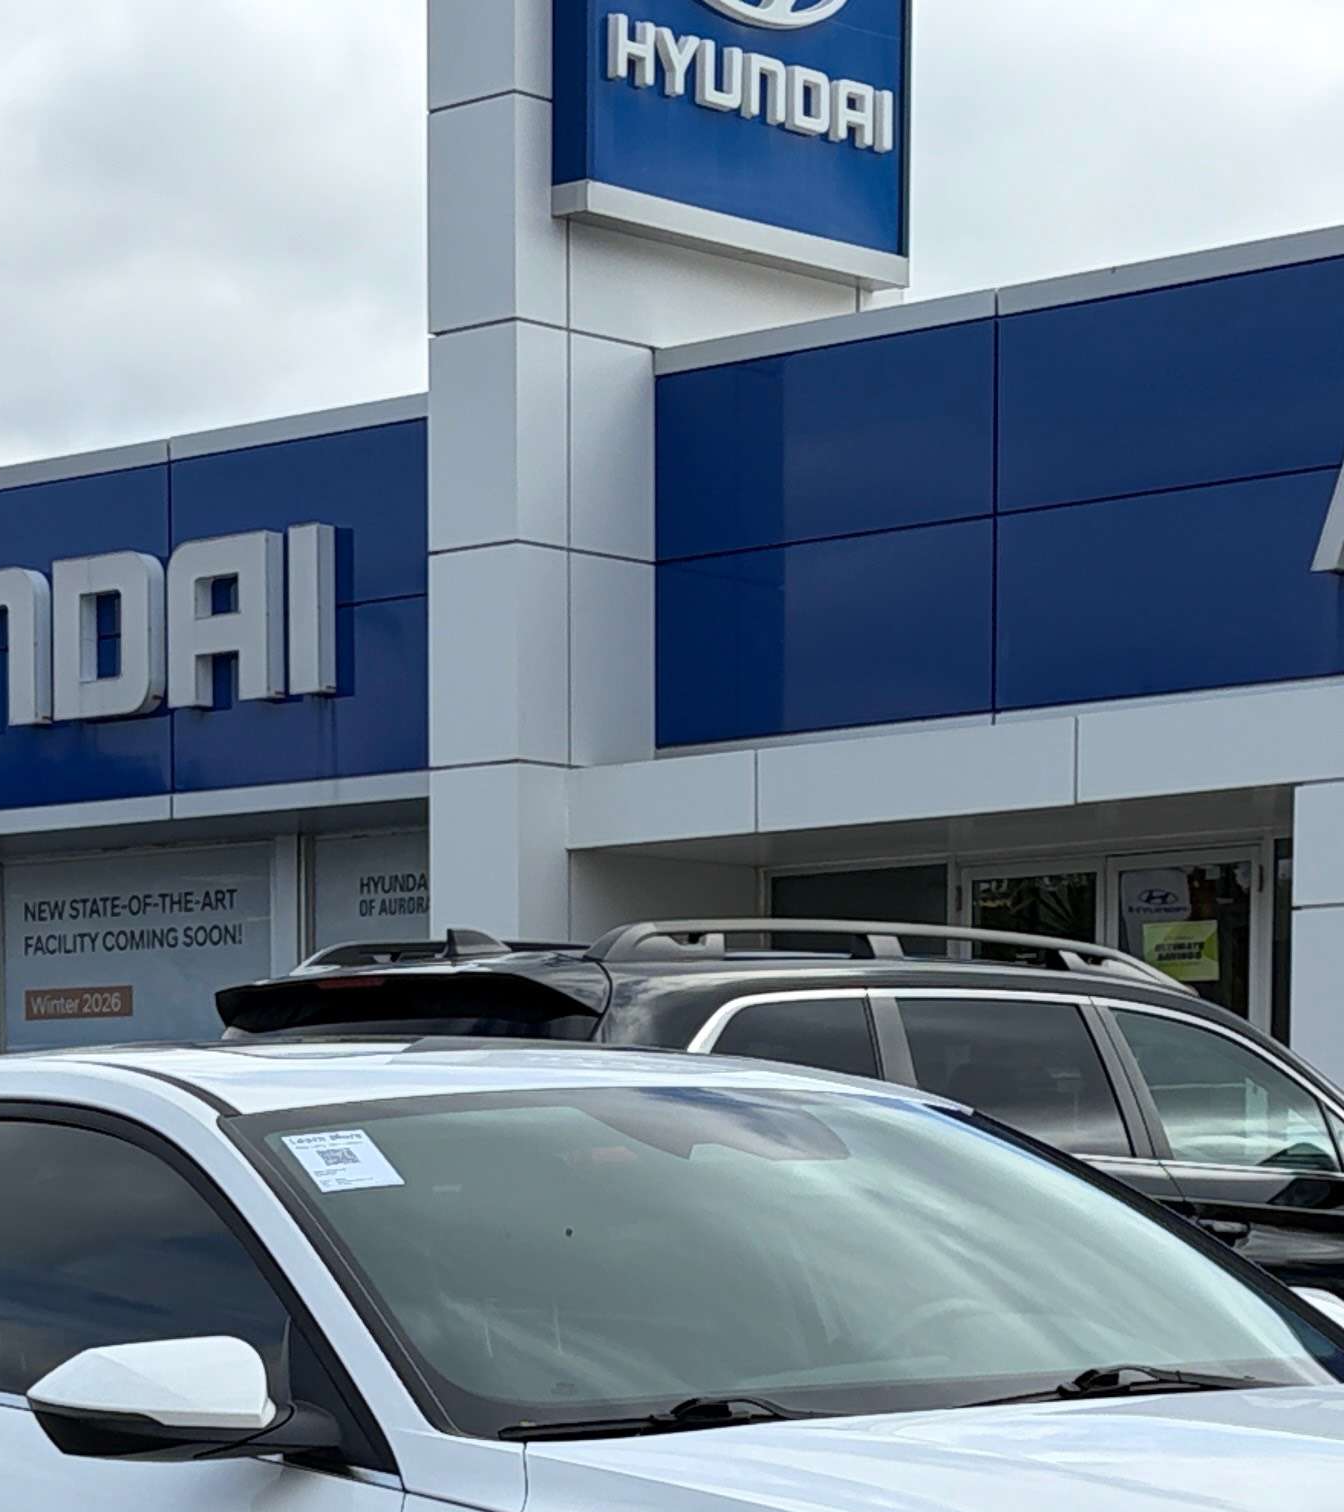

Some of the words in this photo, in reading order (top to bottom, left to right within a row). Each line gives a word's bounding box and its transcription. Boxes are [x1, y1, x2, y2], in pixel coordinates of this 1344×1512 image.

[607, 13, 893, 153] HYUNDAI
[360, 873, 429, 895] HYUNDA
[23, 900, 66, 922] NEW
[69, 888, 238, 919] STATE-OF-THE-ART
[360, 899, 376, 917] OF
[24, 932, 101, 956] FACILITY
[103, 928, 179, 952] COMING
[182, 923, 243, 946] SOON!
[31, 994, 81, 1015] Winter
[82, 992, 122, 1013] 2026
